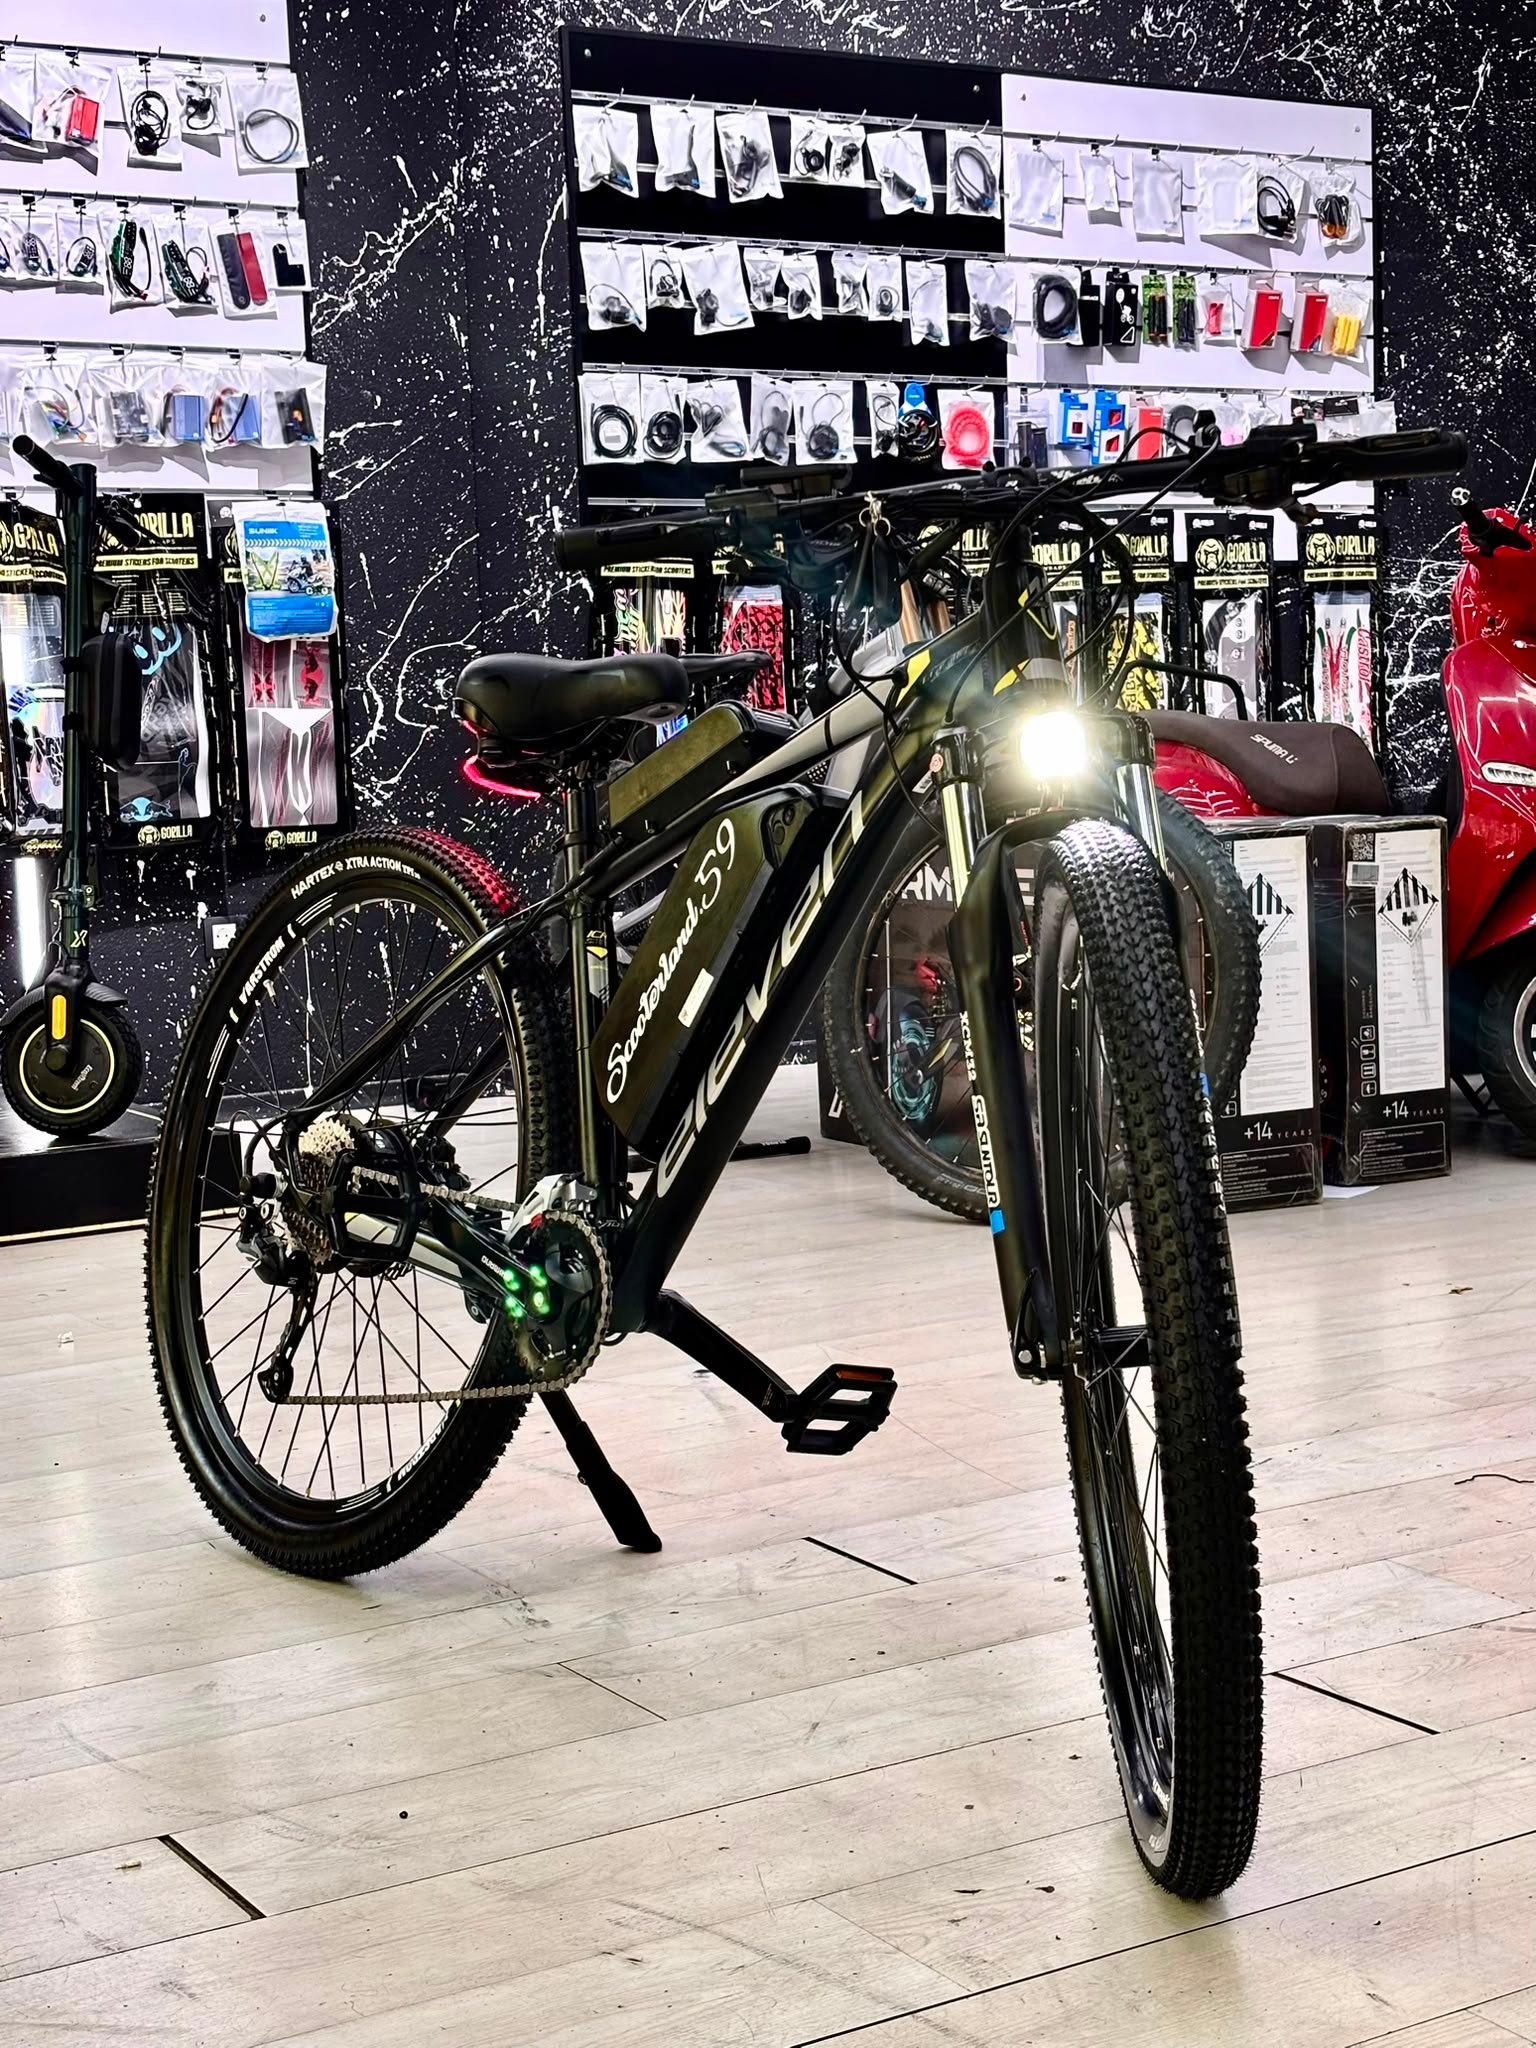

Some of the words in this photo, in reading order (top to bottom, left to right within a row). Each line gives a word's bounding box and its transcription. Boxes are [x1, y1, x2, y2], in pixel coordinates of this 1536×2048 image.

[134, 512, 194, 539] ORILLA
[1130, 534, 1168, 557] GORILLA
[1226, 541, 1266, 563] GORILLA
[1335, 535, 1375, 555] GORILLA
[1249, 733, 1289, 758] SPUMA
[160, 824, 193, 839] GORILLA
[286, 831, 318, 844] GORILLA
[290, 862, 336, 900] HARTEX
[344, 856, 370, 870] XTRA
[370, 856, 402, 871] ACTION
[606, 817, 736, 1104] Scooterland.59
[657, 789, 865, 1198] eleven
[959, 1010, 977, 1082] XCM32
[1383, 1100, 1409, 1119] +14
[1412, 1107, 1445, 1118] YEARS
[1243, 1121, 1273, 1141] +14
[1276, 1128, 1314, 1140] YEARS
